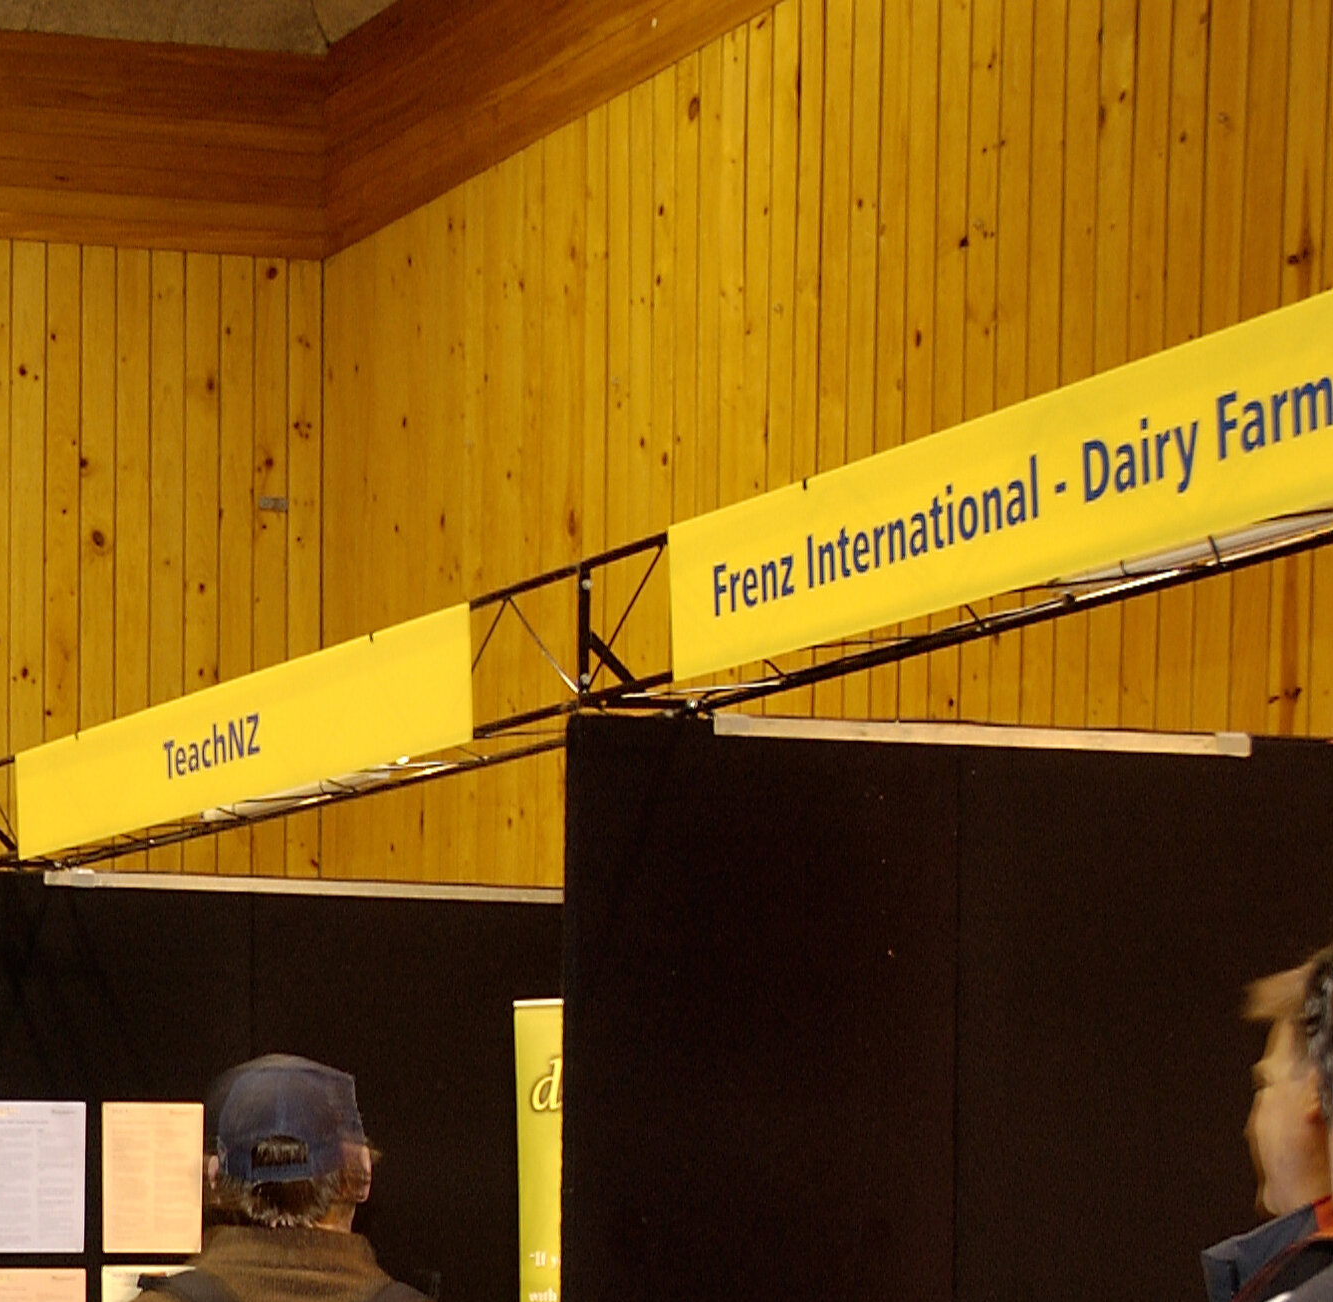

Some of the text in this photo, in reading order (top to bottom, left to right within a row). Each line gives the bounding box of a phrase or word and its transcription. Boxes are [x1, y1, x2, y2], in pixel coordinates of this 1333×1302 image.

[713, 555, 795, 617] Frenz
[807, 453, 1040, 589] International
[1082, 416, 1199, 504] Dairy
[163, 713, 260, 780] TeachNZ
[531, 1055, 562, 1113] d
